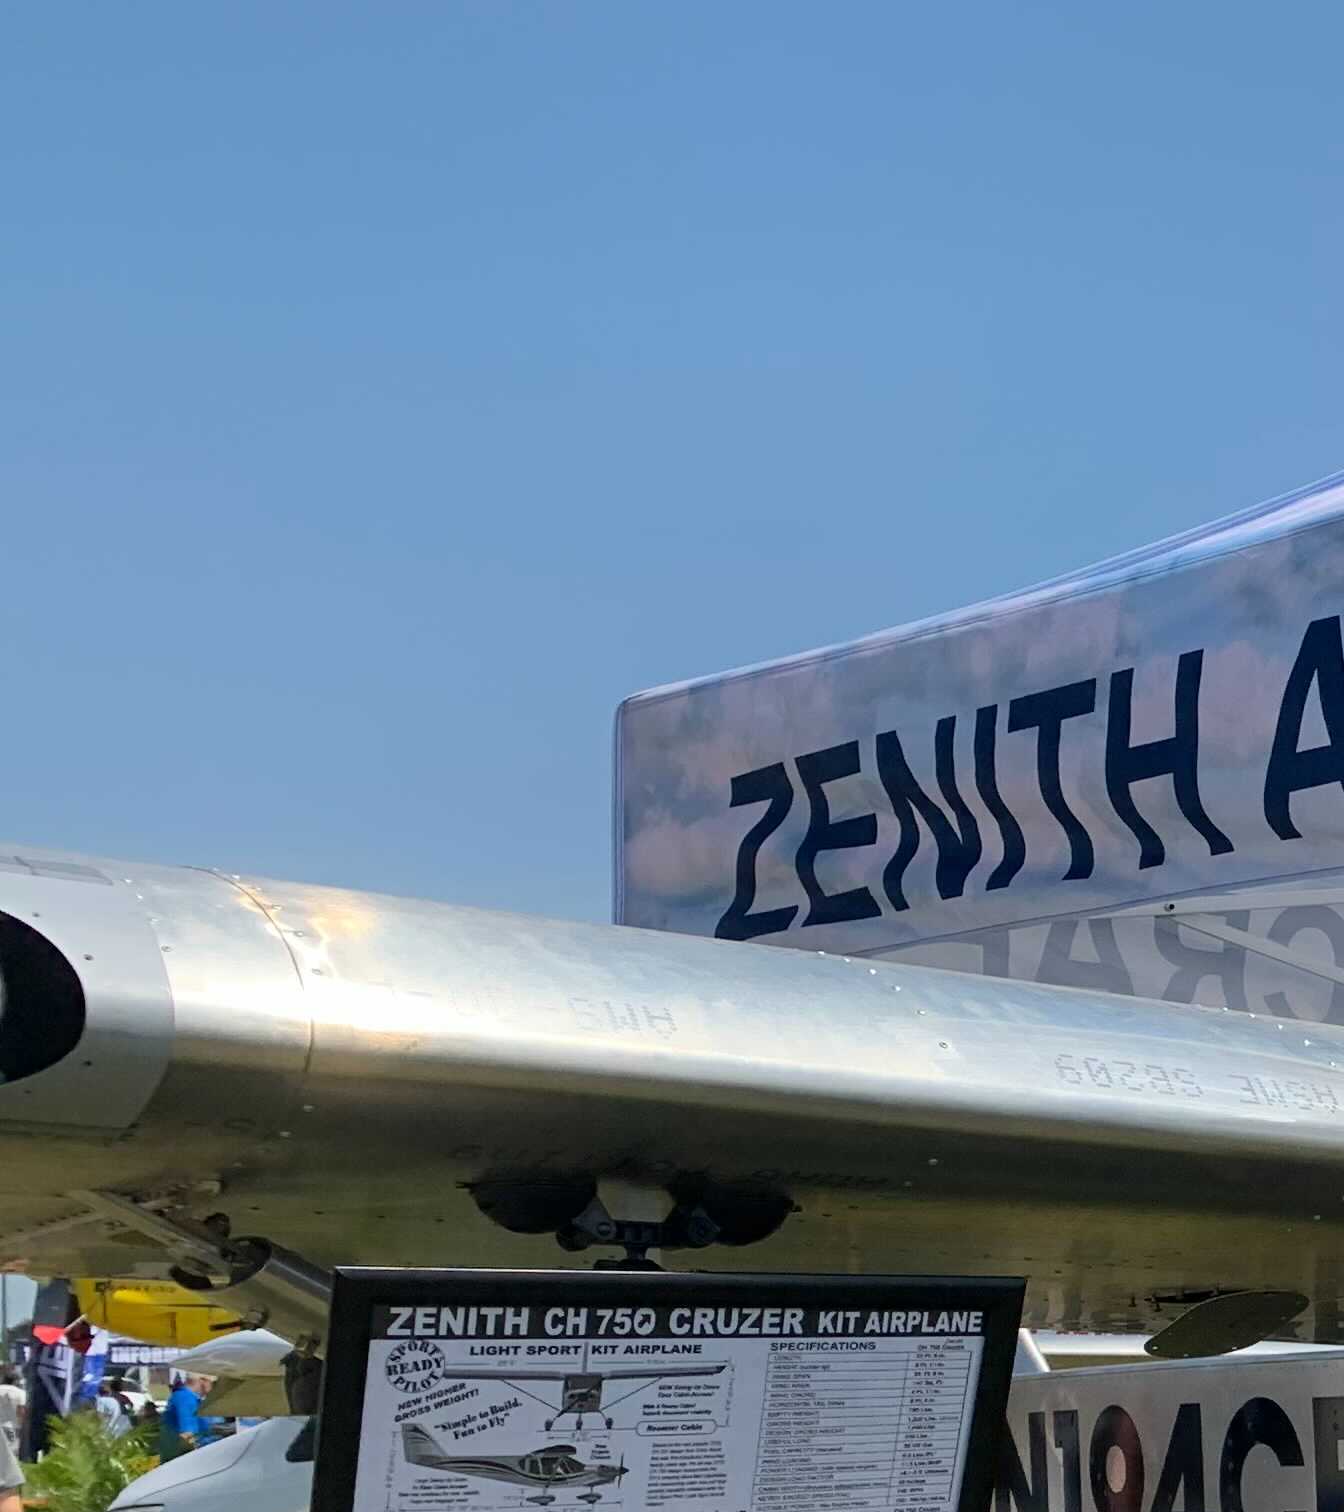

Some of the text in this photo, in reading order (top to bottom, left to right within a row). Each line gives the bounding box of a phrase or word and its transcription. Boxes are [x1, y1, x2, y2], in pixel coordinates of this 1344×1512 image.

[714, 647, 1234, 941] ZENITH
[386, 1307, 984, 1336] ZENITH CH 750 CRUZER KIT AIRPLANE
[469, 1344, 703, 1356] LIGHT SPORT KIT AIRPLANE
[770, 1341, 876, 1352] SPECIFICATIONS
[386, 1356, 444, 1377] READY
[393, 1371, 440, 1393] PILOT
